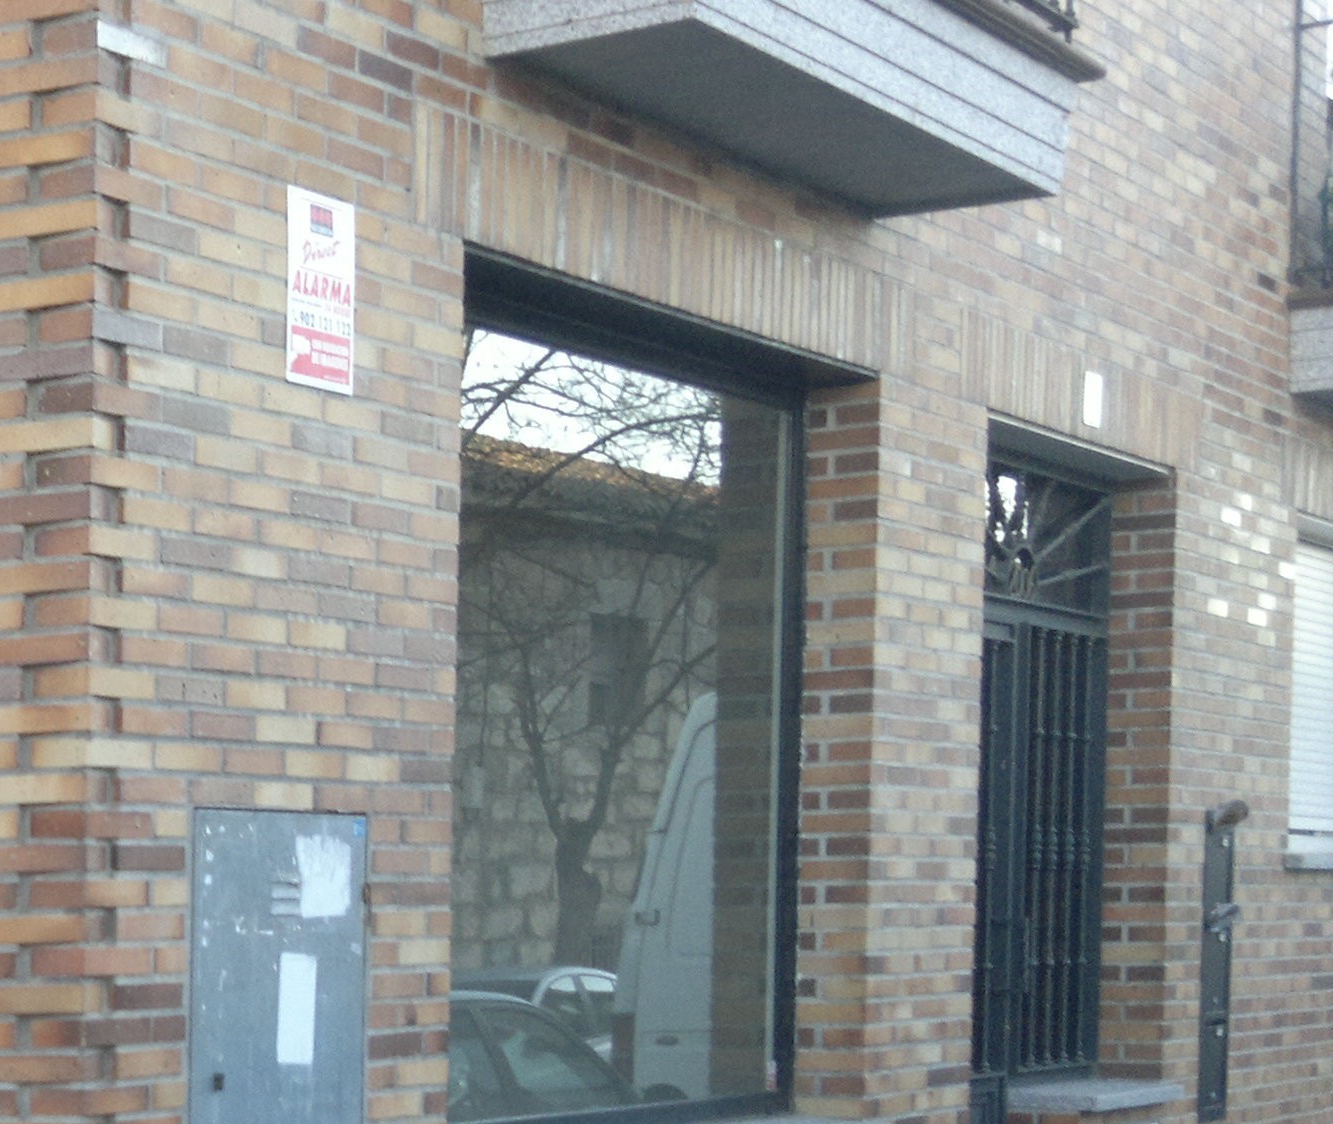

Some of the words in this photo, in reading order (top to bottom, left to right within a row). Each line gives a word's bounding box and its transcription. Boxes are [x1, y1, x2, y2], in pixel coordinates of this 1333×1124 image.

[292, 269, 352, 307] ALARMA
[299, 310, 314, 328] 902
[319, 315, 333, 332] 121
[336, 320, 351, 337] 122
